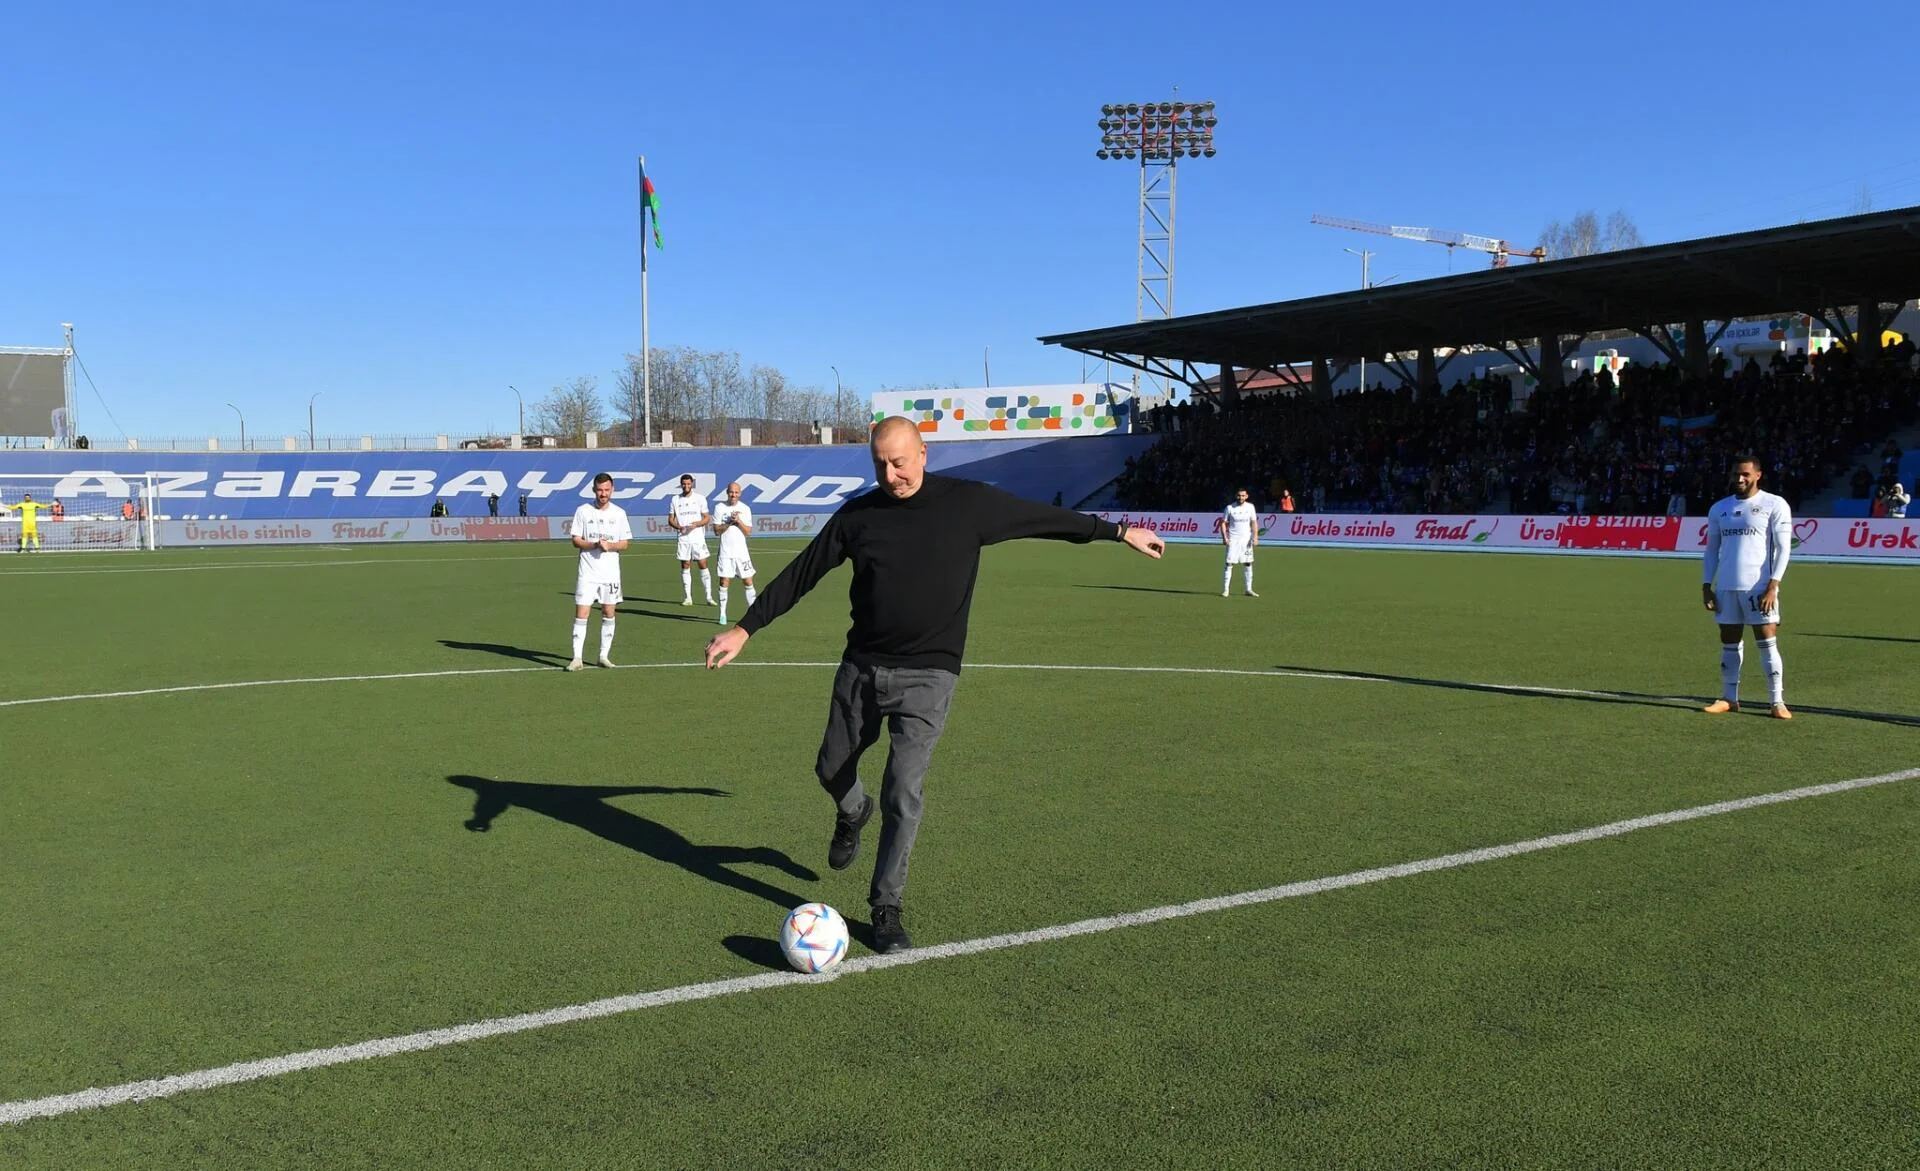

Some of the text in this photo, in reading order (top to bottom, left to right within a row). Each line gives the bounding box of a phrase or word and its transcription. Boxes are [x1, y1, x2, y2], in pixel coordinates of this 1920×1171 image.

[185, 523, 312, 540] Ürəklə sizinlə
[332, 520, 389, 539] Final
[757, 517, 799, 532] Final
[1160, 517, 1198, 532] sizinlə
[1290, 516, 1395, 538] Ürəklə sizinlə
[1414, 518, 1476, 540] Final
[1847, 521, 1920, 549] Ürək
